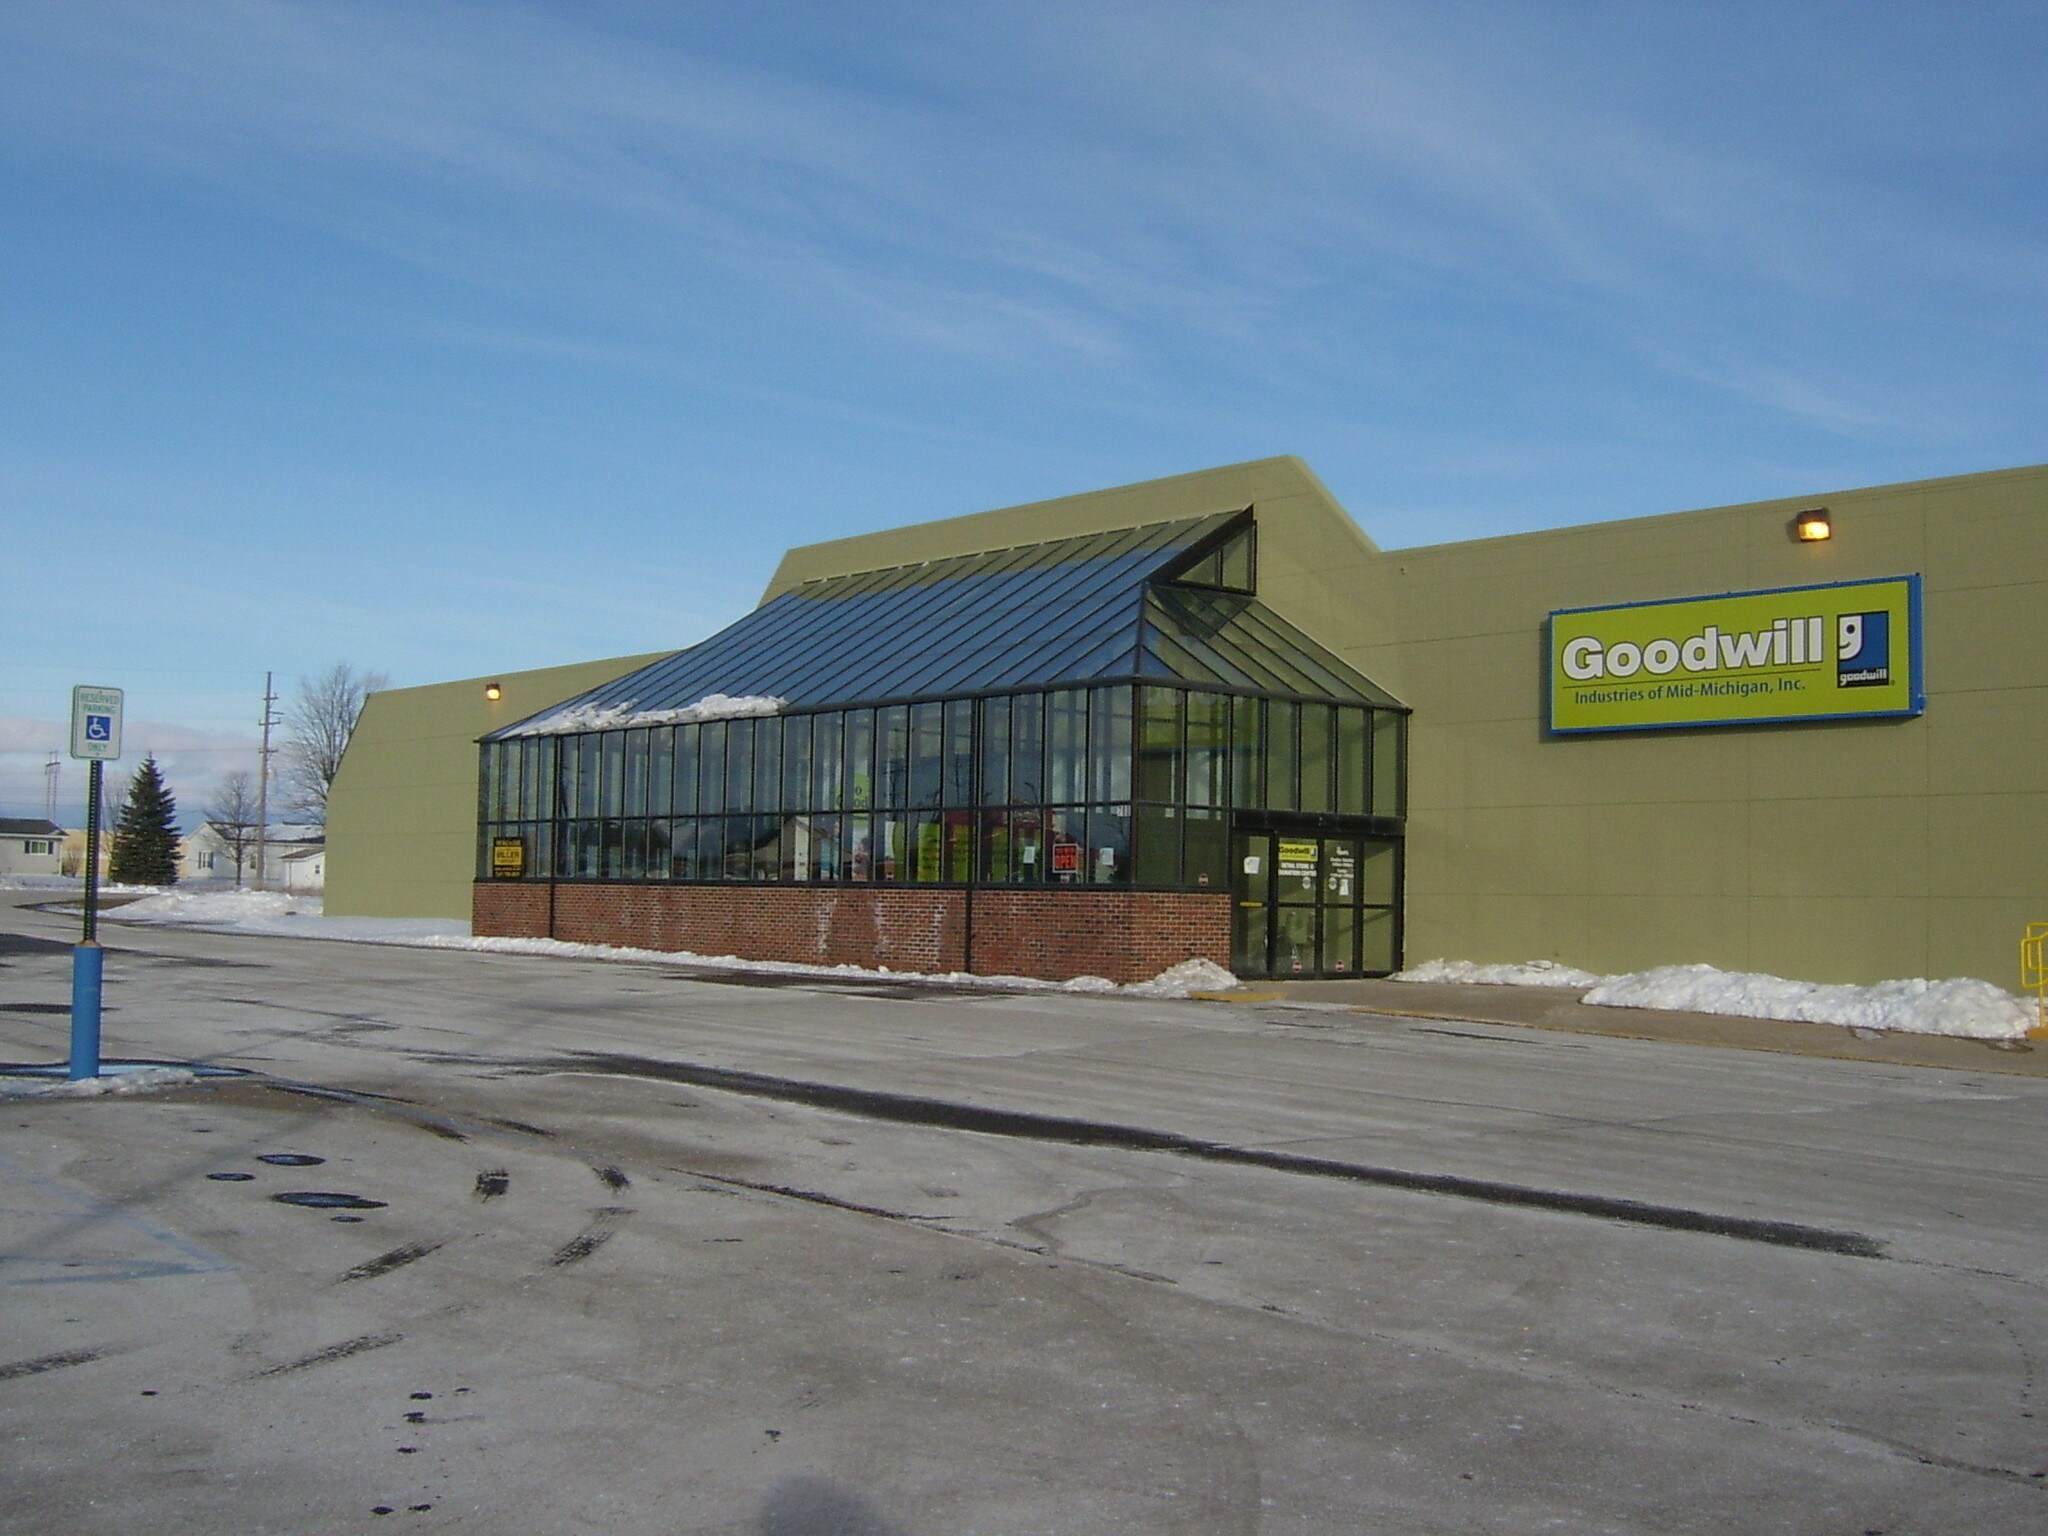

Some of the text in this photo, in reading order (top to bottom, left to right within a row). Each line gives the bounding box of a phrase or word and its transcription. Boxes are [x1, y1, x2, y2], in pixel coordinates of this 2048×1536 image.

[1562, 616, 1823, 681] Goodwill
[1840, 668, 1887, 686] goodwill
[81, 693, 119, 704] RESERVED
[1575, 679, 1806, 705] Industries of Mid-Michigan, Inc.
[83, 704, 116, 714] PARKING
